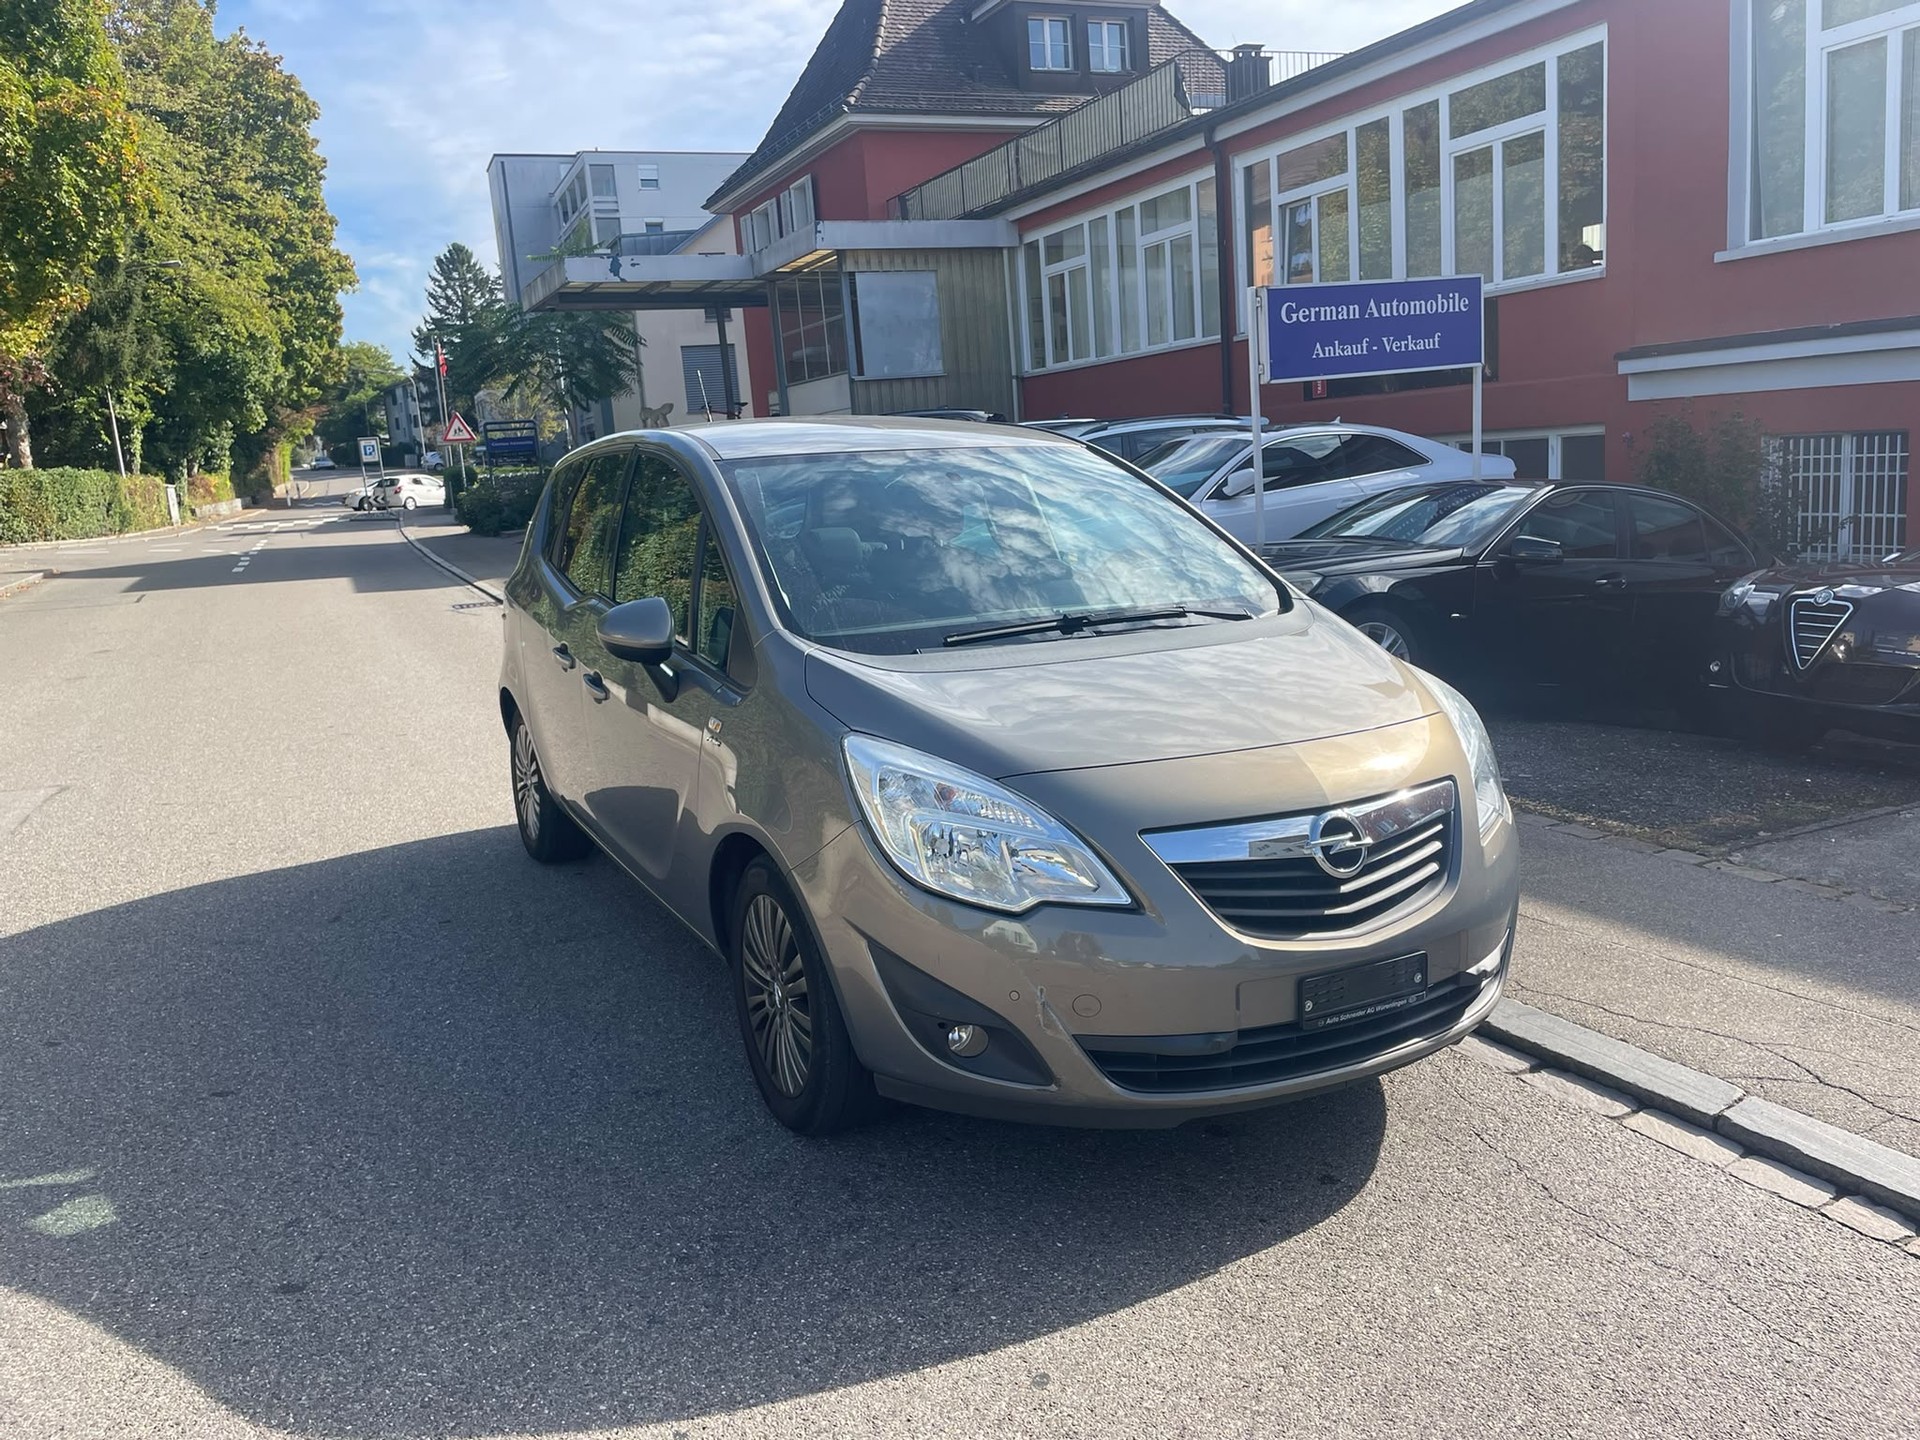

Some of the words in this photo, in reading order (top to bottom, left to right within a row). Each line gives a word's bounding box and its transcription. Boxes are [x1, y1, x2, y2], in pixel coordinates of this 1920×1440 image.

[1280, 302, 1360, 324] German
[1364, 292, 1469, 318] Automobile
[1312, 337, 1370, 359] Ankauf
[1381, 332, 1442, 353] Verkauf
